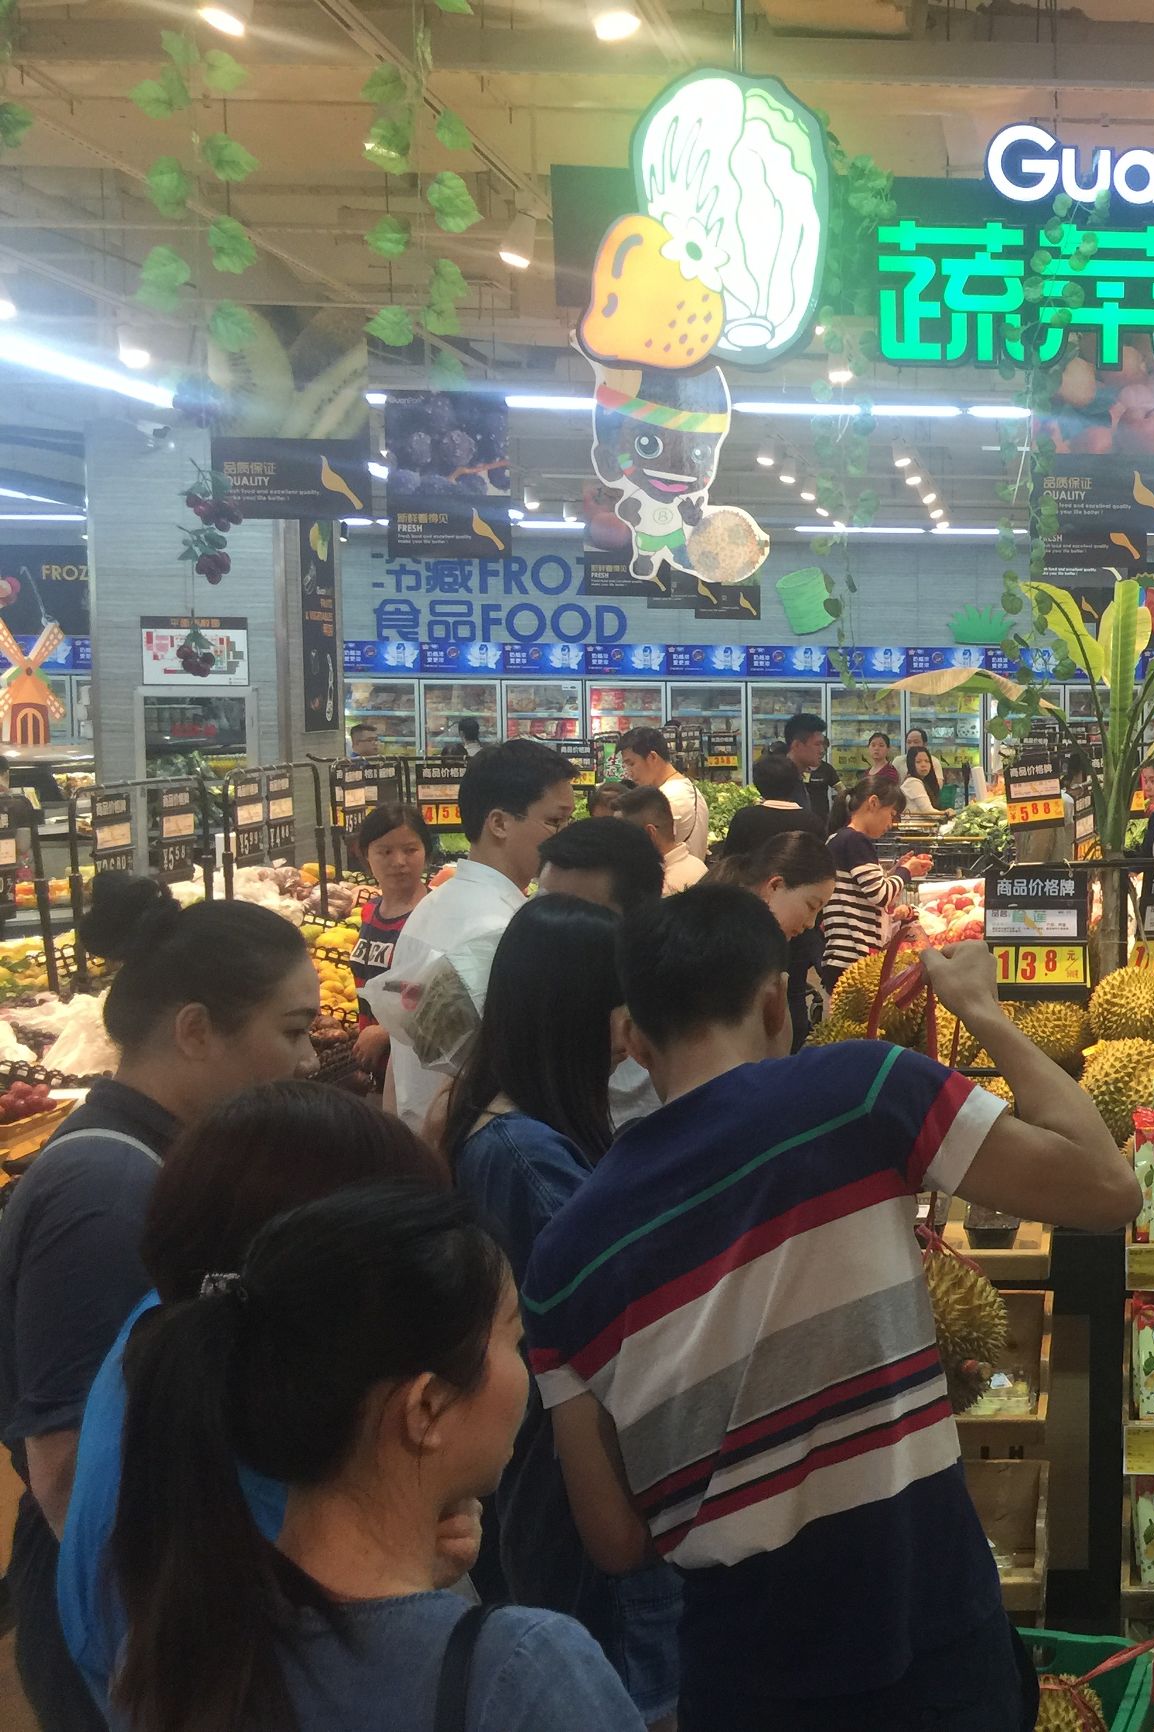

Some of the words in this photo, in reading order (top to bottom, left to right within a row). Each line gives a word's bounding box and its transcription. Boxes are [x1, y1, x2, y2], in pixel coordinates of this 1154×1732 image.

[224, 462, 276, 474] 品质保证
[1044, 476, 1091, 489] 品质保证
[373, 599, 476, 642] 食品
[480, 602, 627, 643] FOOD
[1009, 763, 1053, 777] 商品价格牌
[997, 878, 1076, 896] 商品价格牌
